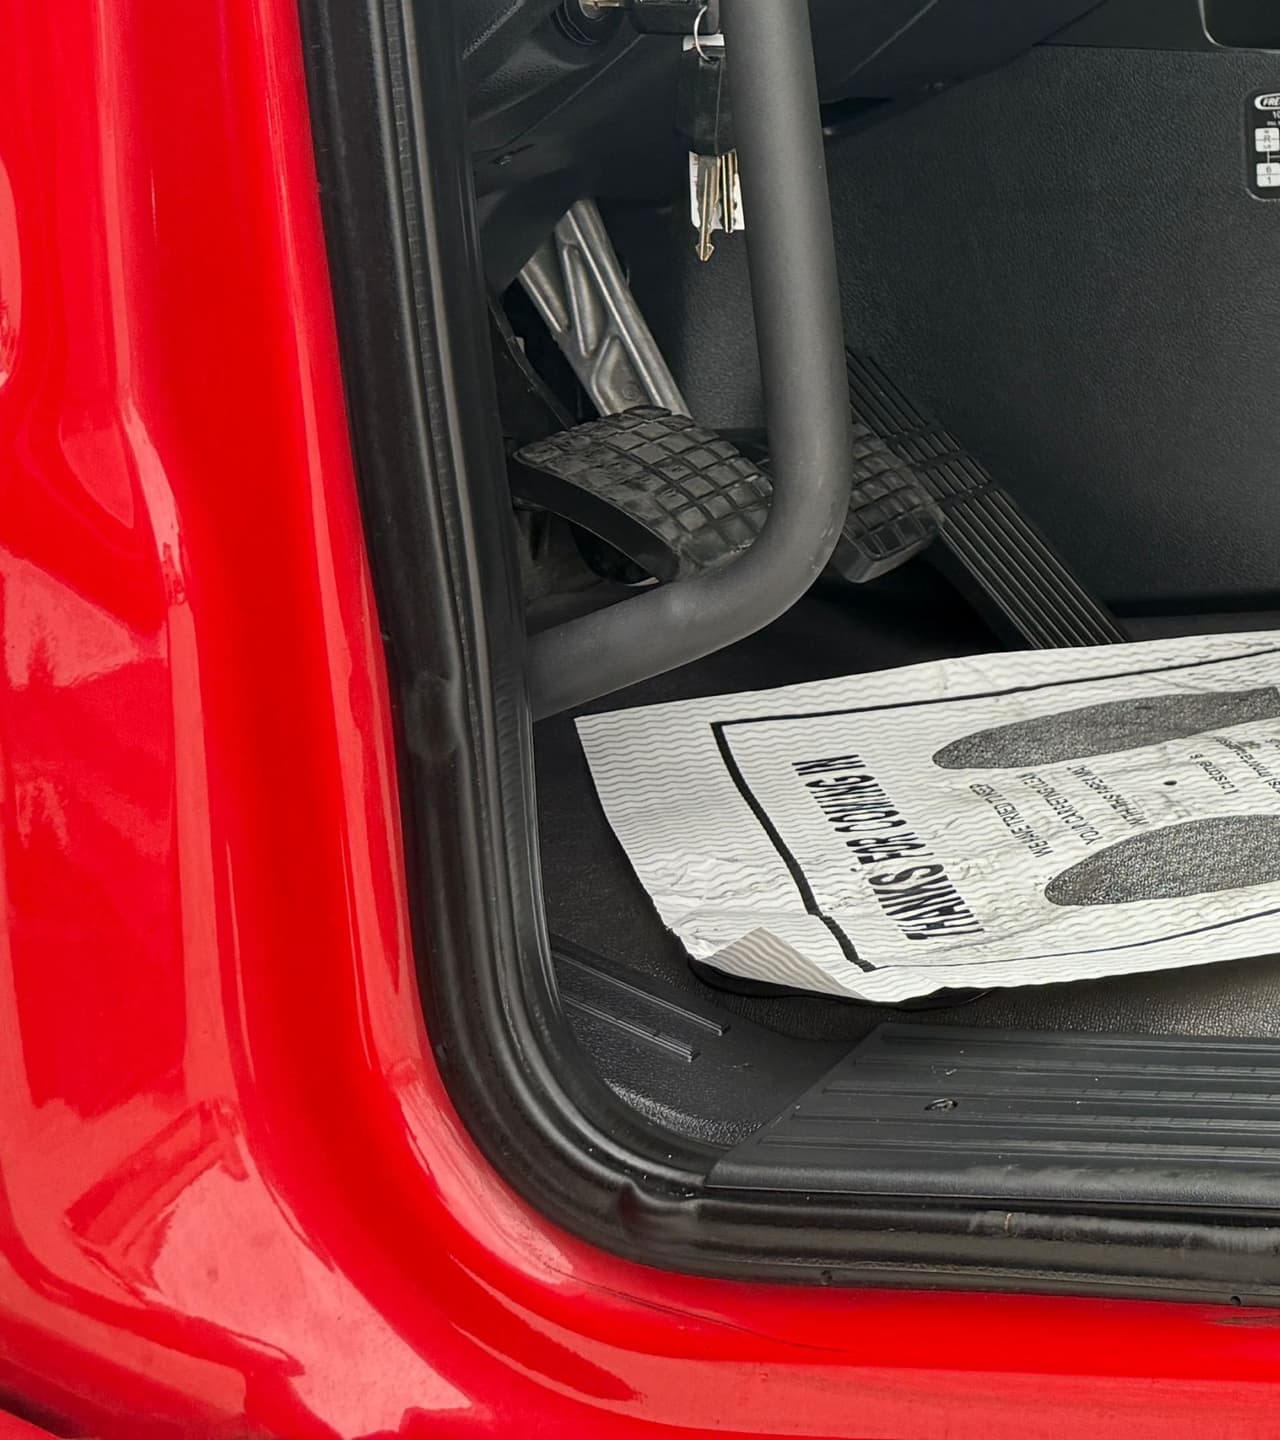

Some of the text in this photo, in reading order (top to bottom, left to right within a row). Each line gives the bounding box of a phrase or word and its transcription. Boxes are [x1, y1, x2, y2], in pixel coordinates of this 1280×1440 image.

[792, 754, 985, 941] THANKS FOR COMING IN
